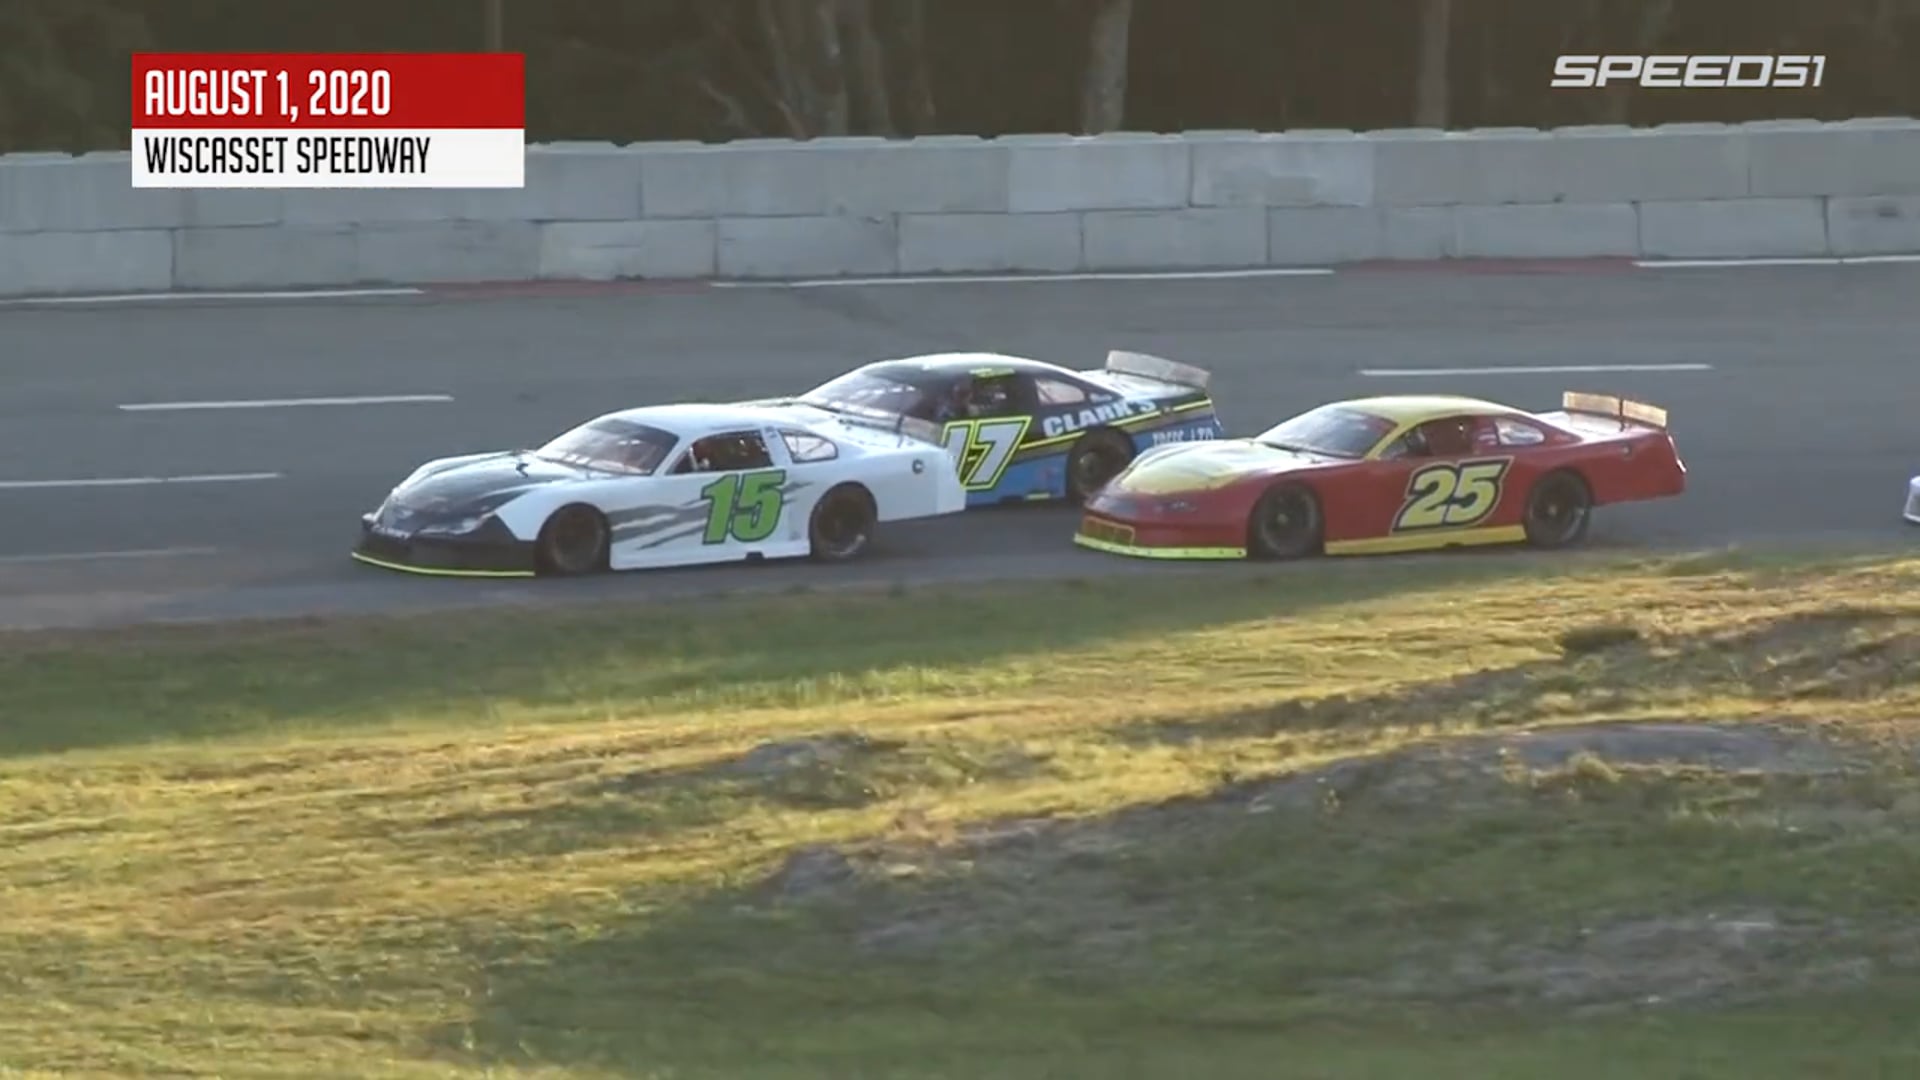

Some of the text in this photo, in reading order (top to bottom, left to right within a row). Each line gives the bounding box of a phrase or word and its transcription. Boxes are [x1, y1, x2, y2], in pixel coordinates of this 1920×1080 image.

[941, 415, 1033, 491] 17
[1042, 399, 1158, 438] CLARK'S
[701, 469, 786, 546] 15
[1391, 456, 1514, 534] 25
